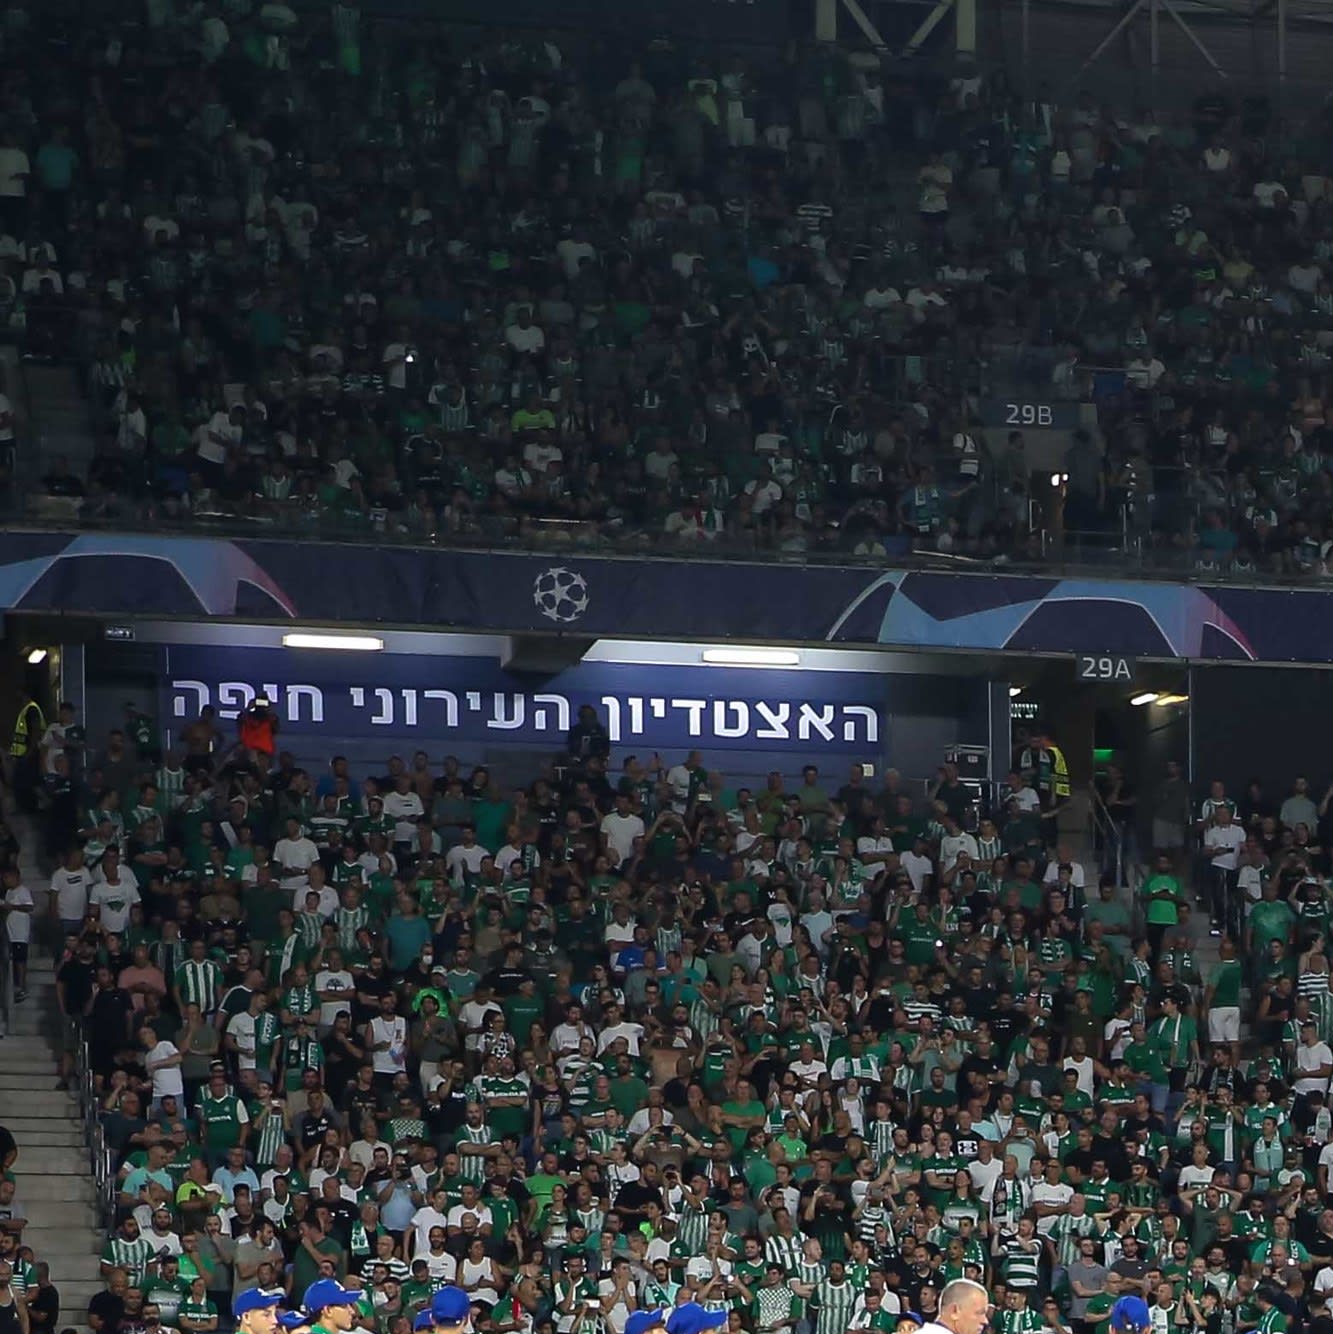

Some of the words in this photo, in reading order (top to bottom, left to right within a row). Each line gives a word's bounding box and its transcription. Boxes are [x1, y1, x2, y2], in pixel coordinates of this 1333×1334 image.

[1006, 404, 1053, 425] 29B
[1082, 656, 1131, 680] 29A
[173, 680, 324, 722] חיפה
[350, 686, 570, 731] העירוני
[602, 696, 879, 742] האצטדיון
